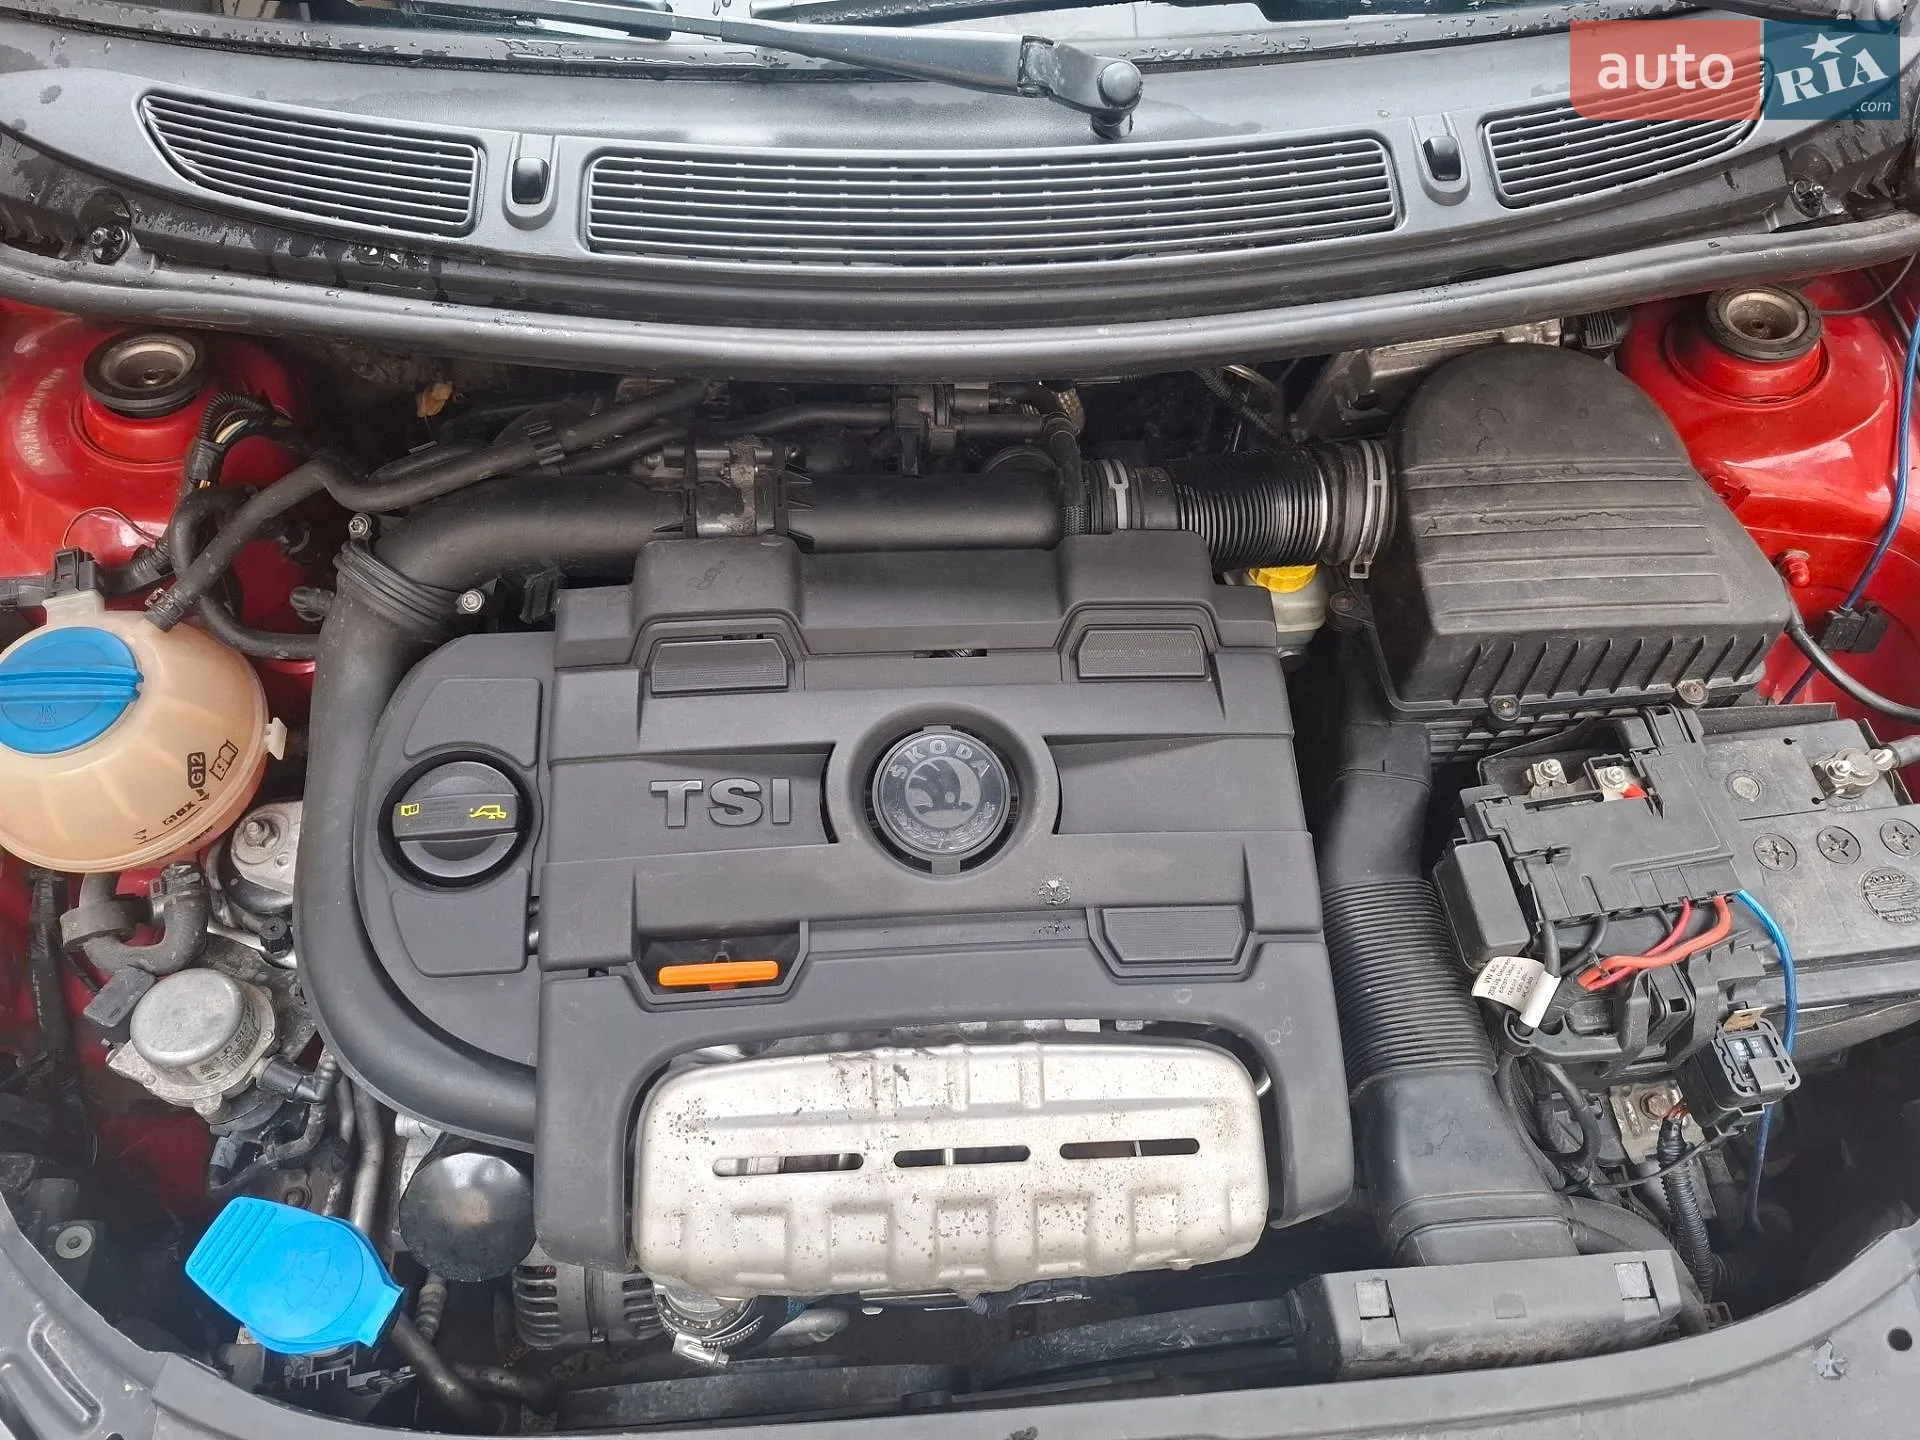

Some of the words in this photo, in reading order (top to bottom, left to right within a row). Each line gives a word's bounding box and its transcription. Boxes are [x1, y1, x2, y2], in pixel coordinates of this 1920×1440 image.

[190, 753, 204, 785] G12
[888, 739, 991, 780] SKODA
[162, 801, 196, 826] max
[649, 777, 791, 829] TSI
